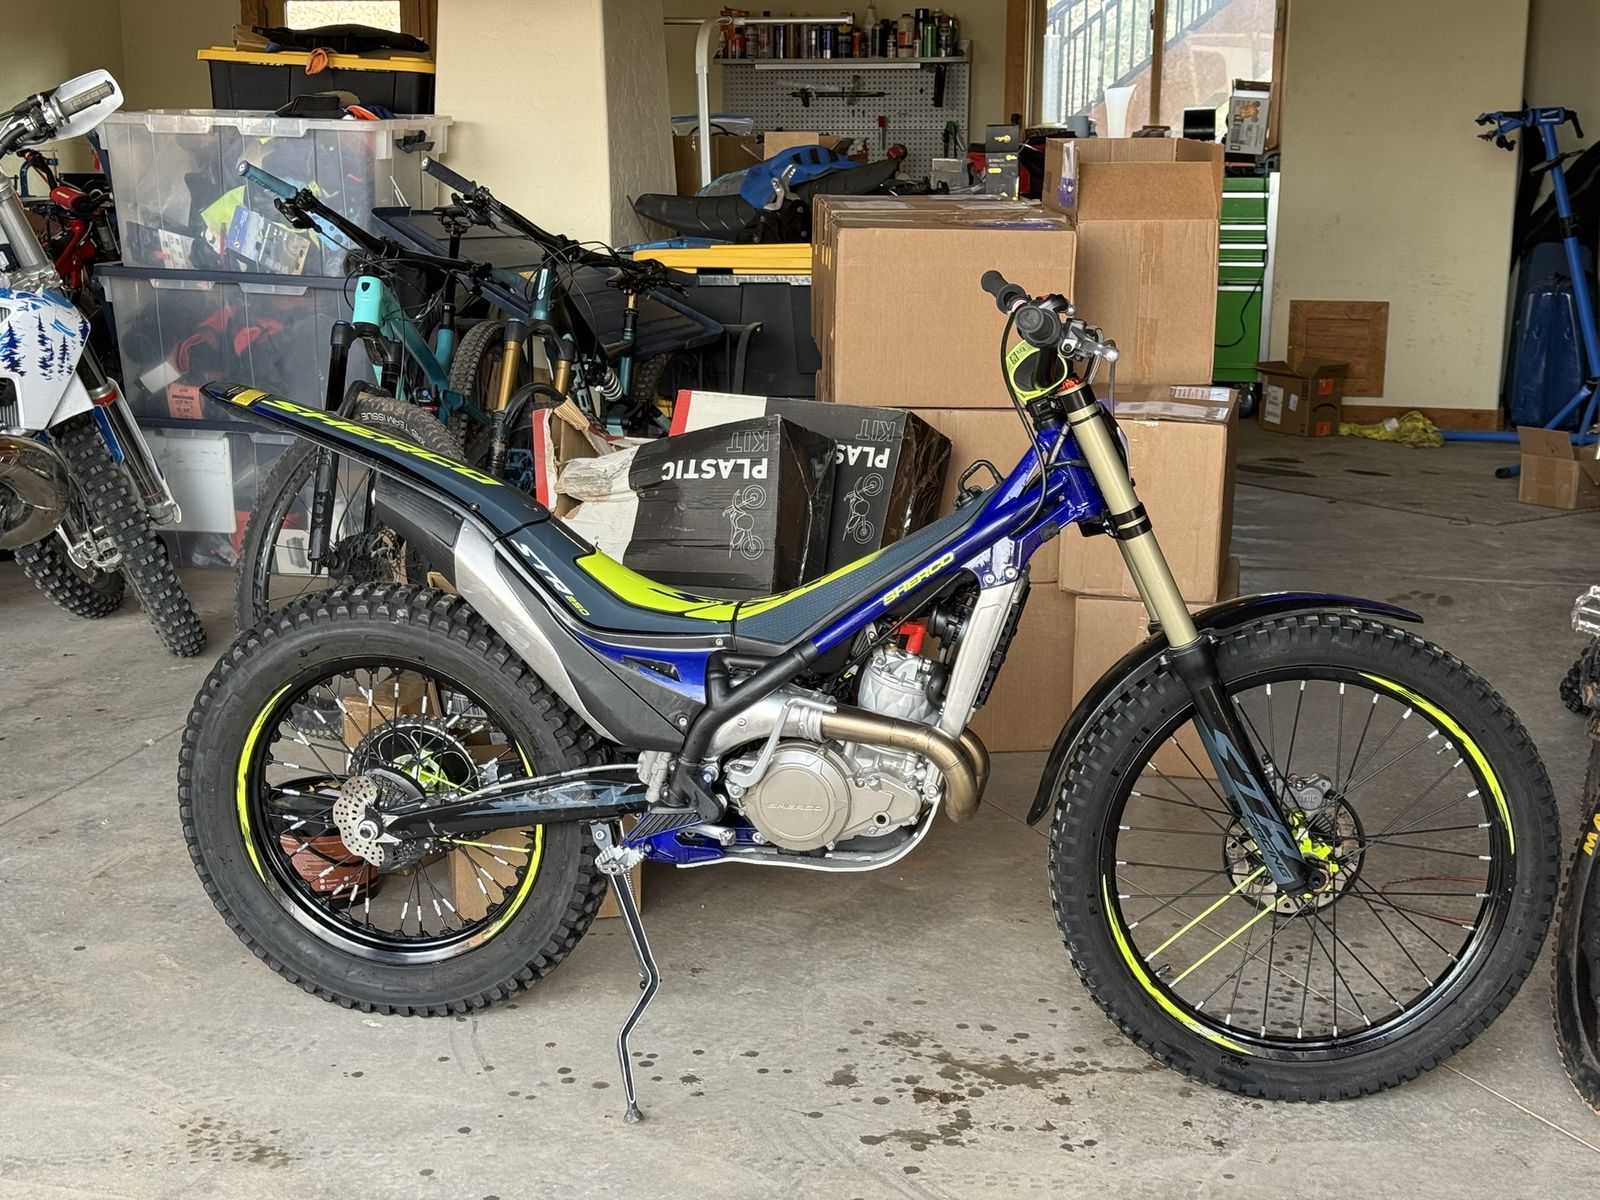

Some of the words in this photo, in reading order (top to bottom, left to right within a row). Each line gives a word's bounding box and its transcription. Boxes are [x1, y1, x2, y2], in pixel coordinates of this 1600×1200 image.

[361, 412, 386, 421] ISSUE
[386, 414, 410, 433] TEAM
[261, 400, 504, 486] SHERCO
[726, 430, 770, 453] KIT
[855, 418, 896, 443] KIT
[661, 457, 768, 481] PLASTIC
[835, 444, 891, 469] PLAS
[510, 539, 575, 596] STR
[564, 595, 590, 616] 250
[882, 551, 956, 606] SHERCO
[767, 803, 823, 812] SHERCO
[1247, 814, 1292, 879] RACING
